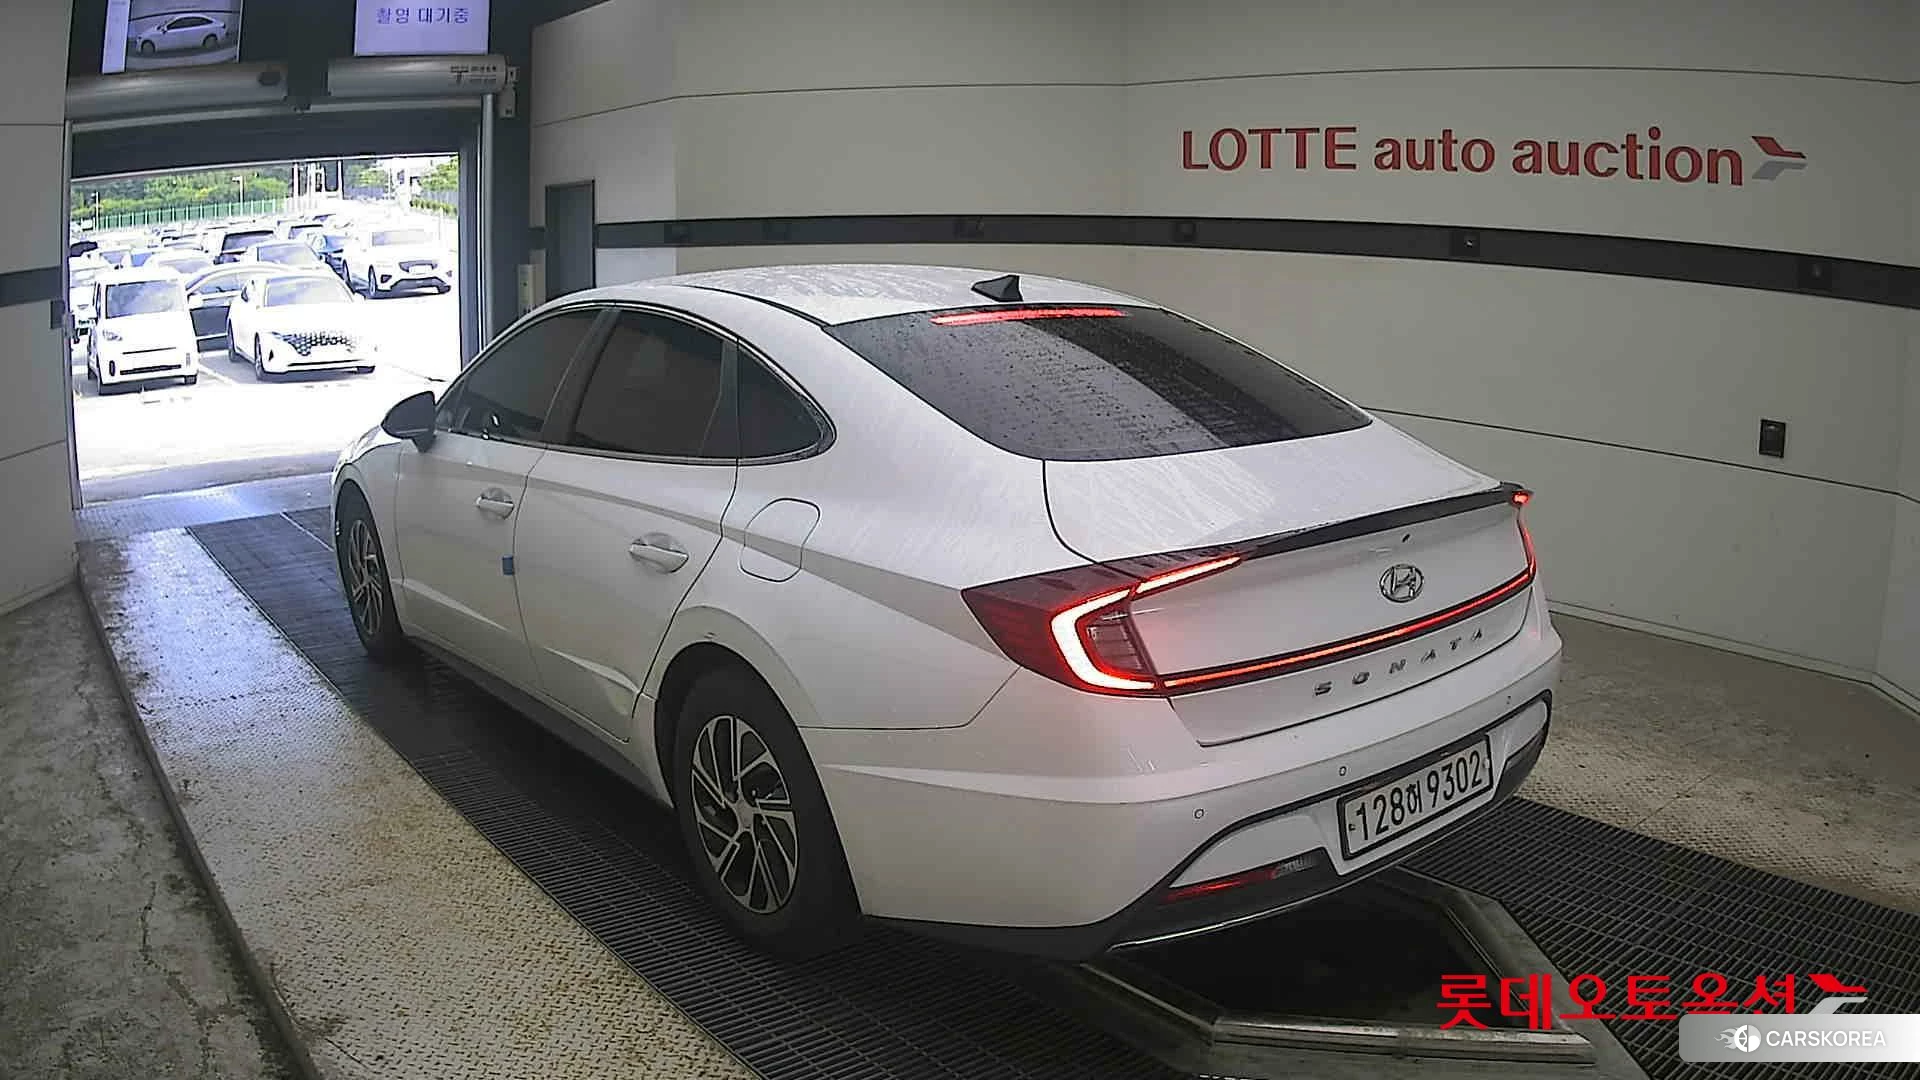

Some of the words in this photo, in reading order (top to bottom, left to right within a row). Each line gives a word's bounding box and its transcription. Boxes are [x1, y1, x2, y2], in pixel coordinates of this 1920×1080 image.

[417, 7, 470, 24] 대기중
[1182, 126, 1357, 171] LOTTE
[1374, 128, 1496, 172] auto
[1511, 126, 1743, 186] auction
[1314, 628, 1483, 696] SONATA
